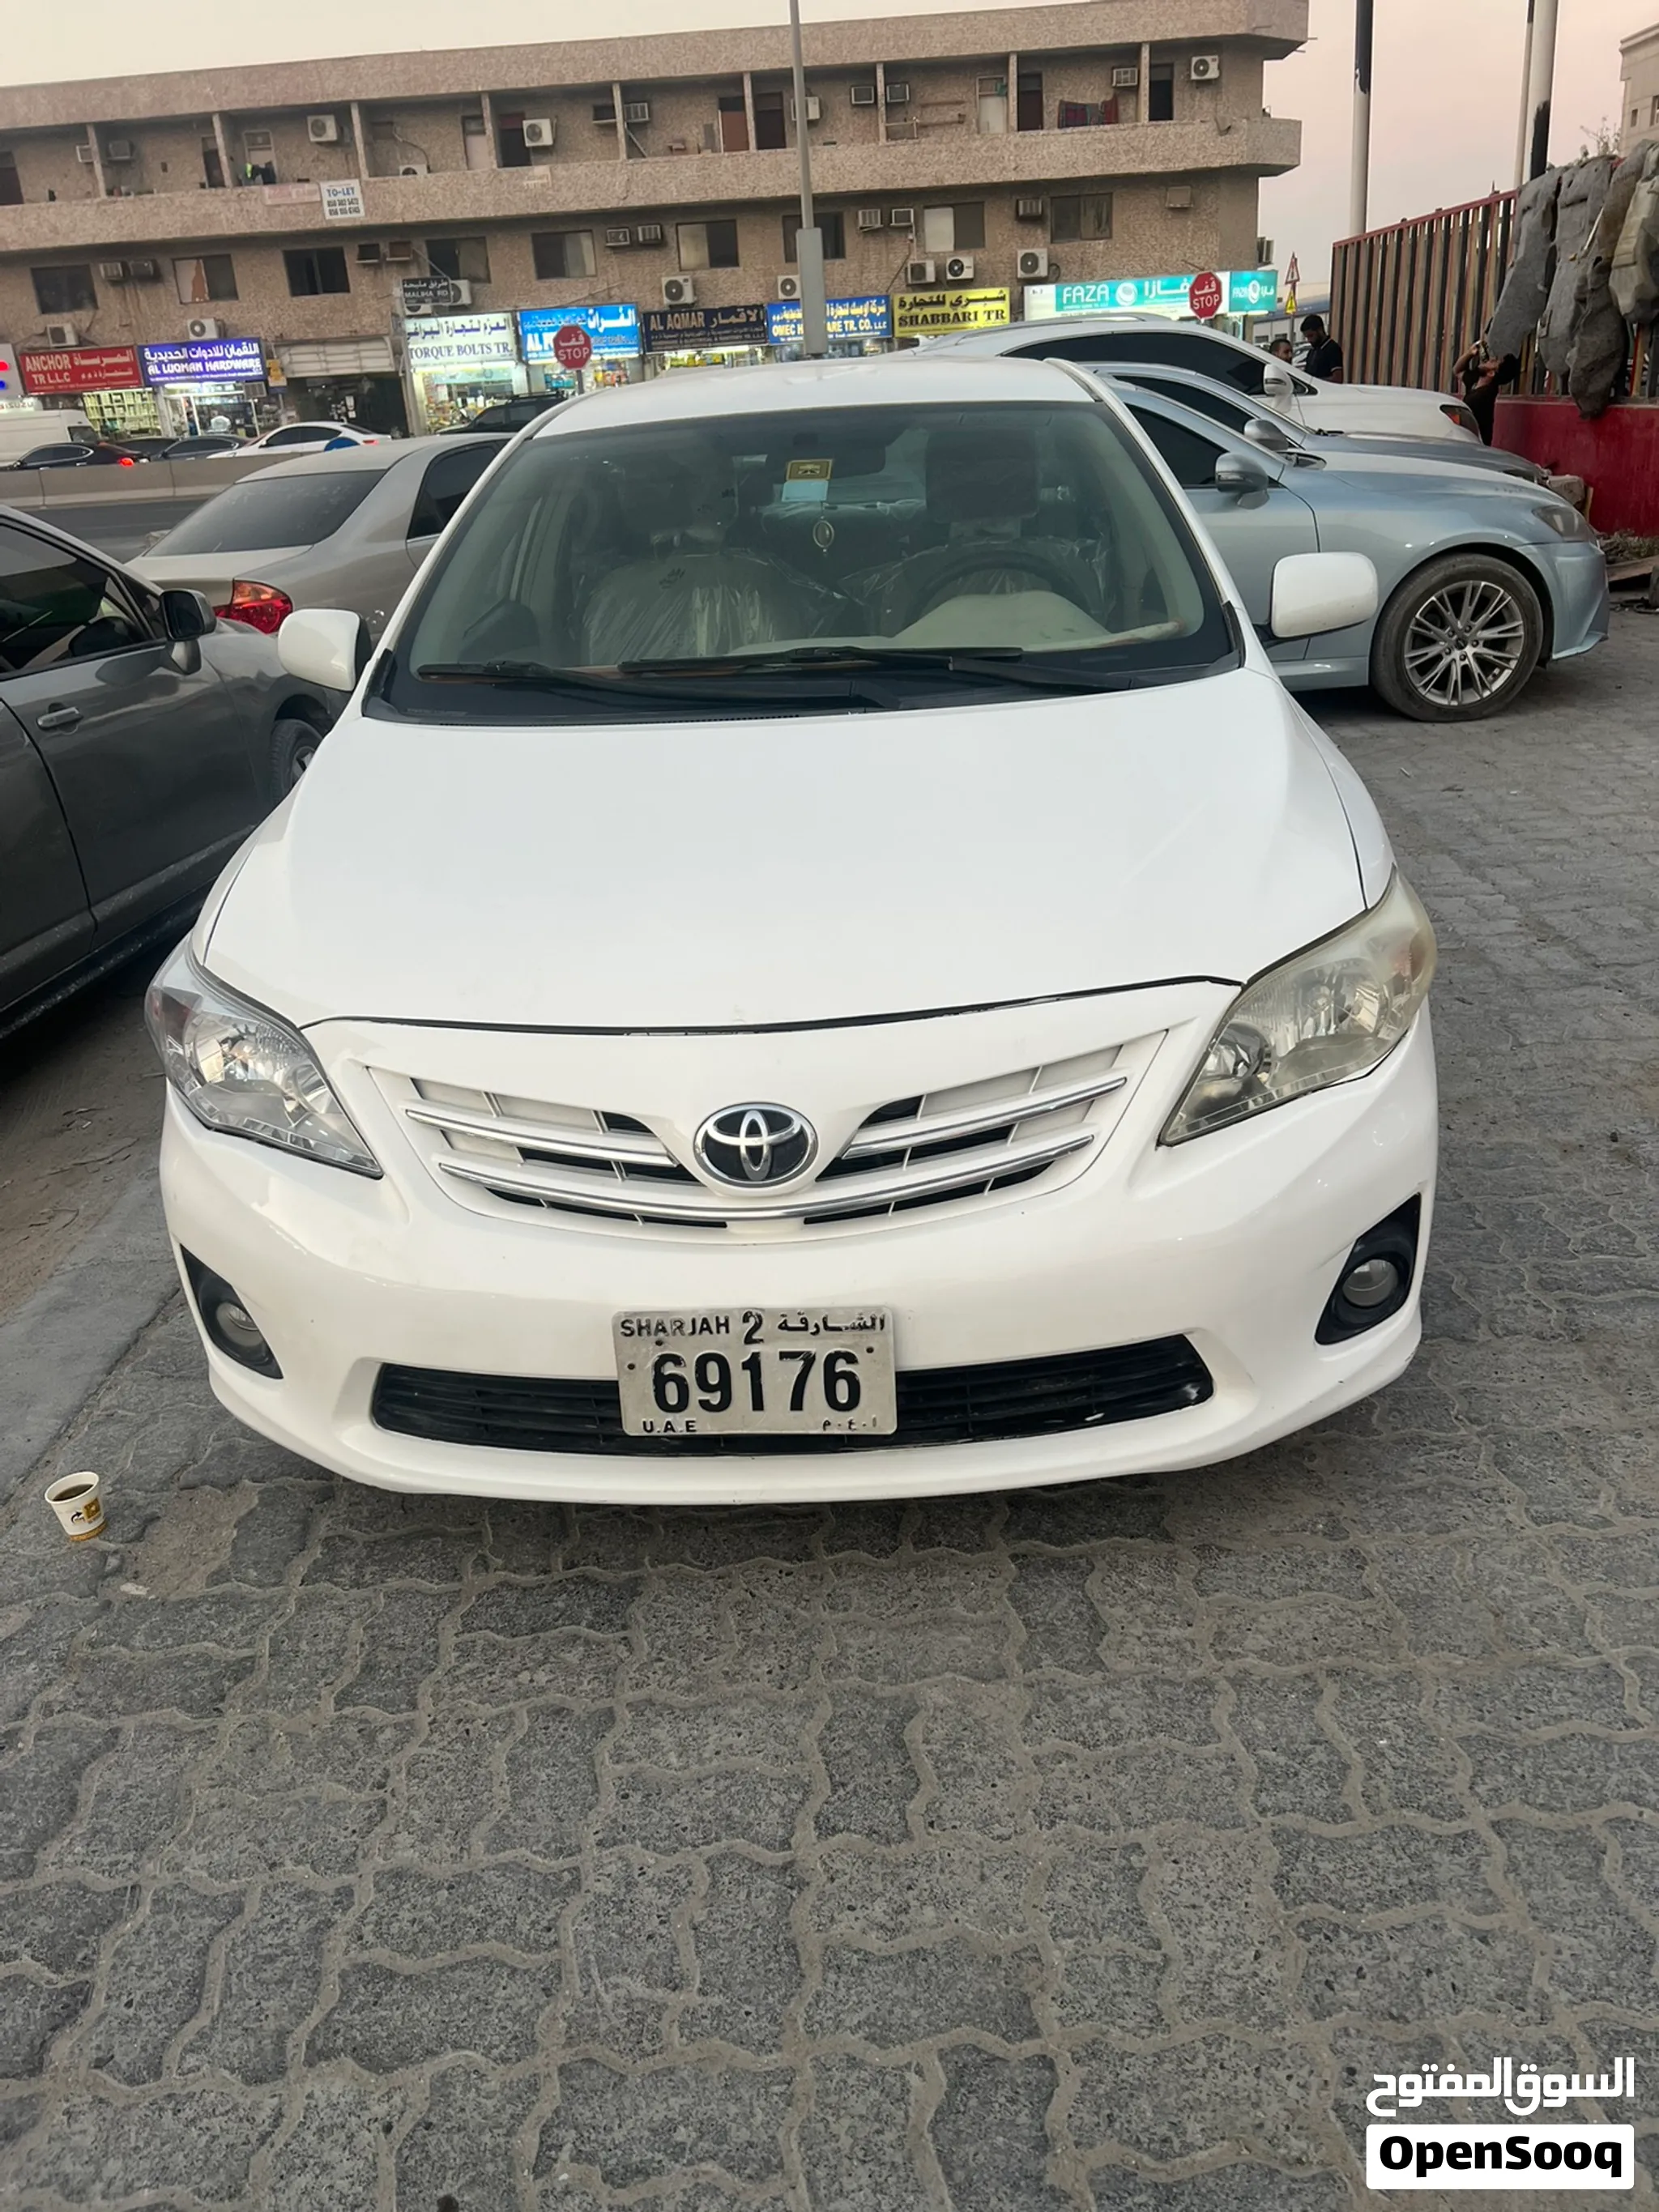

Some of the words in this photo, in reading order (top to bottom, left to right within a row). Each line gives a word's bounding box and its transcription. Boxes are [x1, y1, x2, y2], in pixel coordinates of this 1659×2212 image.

[326, 186, 355, 197] TO-LET
[1063, 283, 1110, 304] FAZA
[1194, 277, 1216, 295] قف
[1192, 295, 1220, 309] STOP
[650, 315, 663, 331] AL
[667, 312, 705, 330] AQMAR
[898, 311, 979, 328] SHABBARI
[983, 309, 1006, 321] TR
[527, 333, 543, 352] AL
[559, 330, 585, 346] قف
[409, 345, 454, 360] TORQUE
[457, 342, 493, 356] BOLTS
[558, 347, 590, 360] STOP
[26, 353, 71, 372] ANCHOR
[147, 364, 161, 375] AL
[162, 362, 203, 375] LUQMAN
[205, 357, 261, 373] HARDWARE
[32, 373, 46, 385] TR
[621, 1315, 730, 1336] SHARJAH
[741, 1310, 765, 1345] 2
[778, 1312, 885, 1336] الشارقة
[652, 1349, 861, 1413] 69176
[642, 1420, 697, 1434] U.A.E
